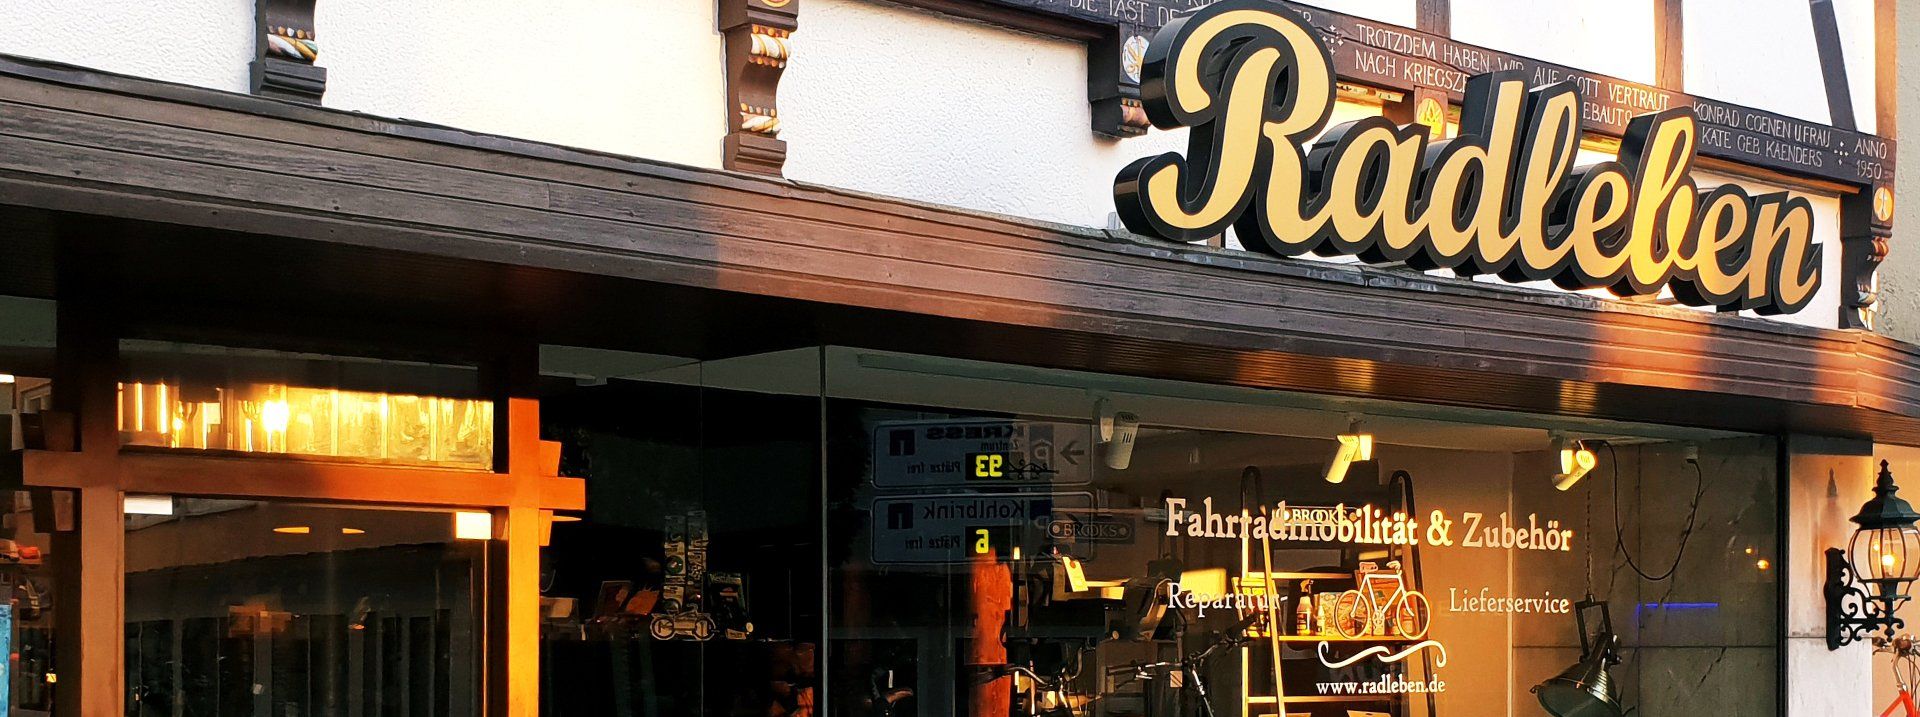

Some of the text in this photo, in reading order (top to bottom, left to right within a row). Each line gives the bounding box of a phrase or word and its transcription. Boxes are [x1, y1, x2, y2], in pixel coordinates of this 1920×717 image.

[1355, 50, 1397, 78] NACH
[1356, 24, 1437, 60] TROTZDEM
[1443, 43, 1490, 73] HABEN
[1608, 82, 1671, 111] VERTRAUT
[1693, 101, 1740, 128] KONRAD
[1745, 113, 1791, 139] COENEN
[1126, 6, 1816, 310] Radleben
[1702, 126, 1731, 149] KATE
[1765, 141, 1823, 168] KAENDERS
[1854, 138, 1887, 160] ANNO
[1856, 160, 1882, 180] 1950
[1063, 523, 1118, 537] BROOKS
[1165, 497, 1572, 552] Fahrradmobilität & Zubehör
[1449, 587, 1570, 614] Lieferservice
[1316, 673, 1446, 694] www.radleben.de
